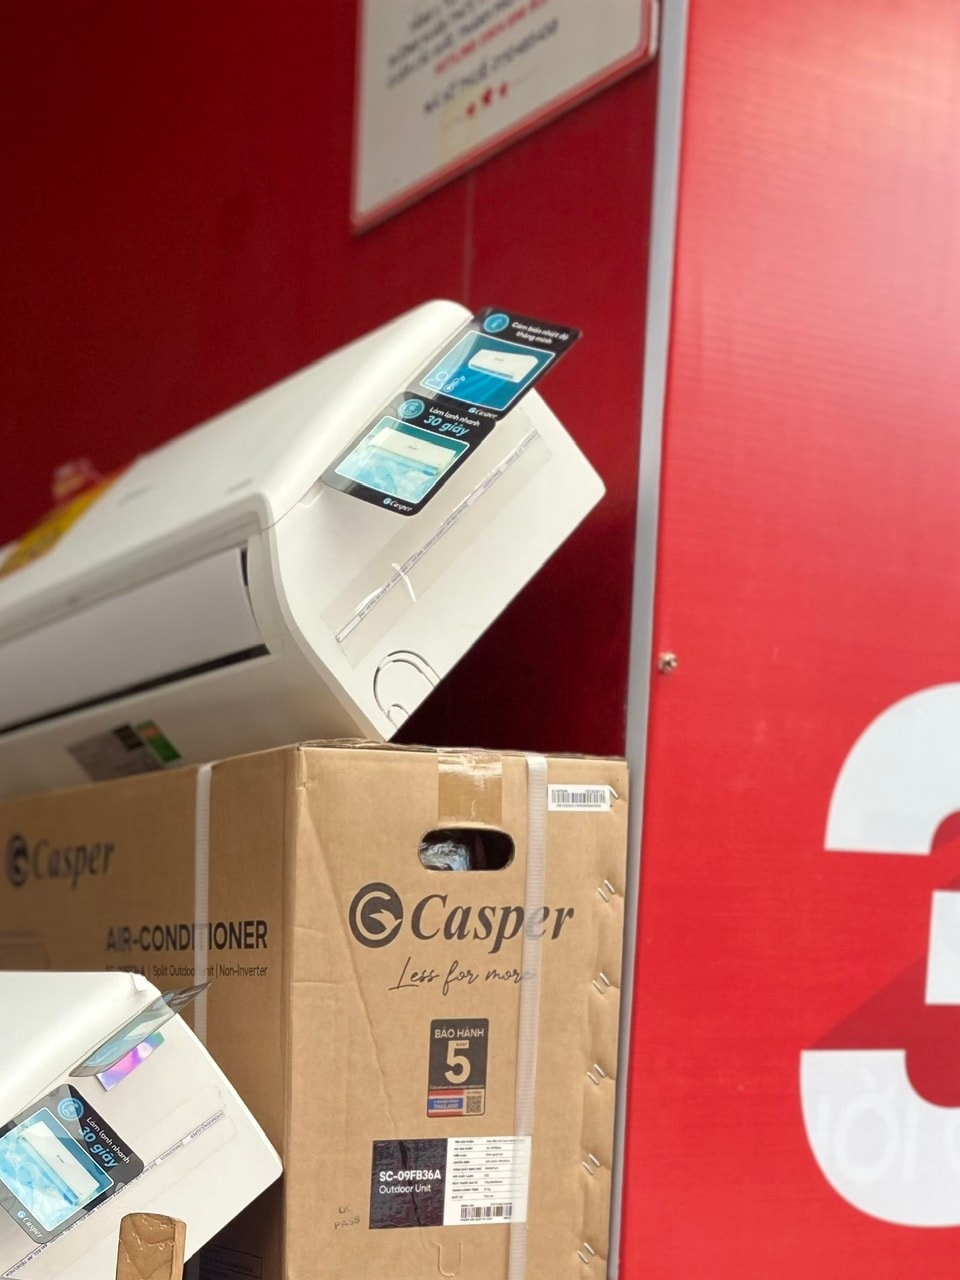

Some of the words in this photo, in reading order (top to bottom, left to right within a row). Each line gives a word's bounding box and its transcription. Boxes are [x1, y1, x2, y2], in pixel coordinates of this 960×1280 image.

[423, 414, 441, 427] 30
[441, 417, 471, 438] giây
[459, 415, 480, 427] nhanh
[31, 839, 116, 890] Casper
[410, 893, 575, 954] Casper
[153, 964, 168, 979] Split
[170, 964, 198, 976] Outdoo
[218, 963, 269, 976] Non-Inverter
[388, 956, 441, 992] Less
[441, 960, 480, 996] for
[434, 1025, 455, 1039] BẢO
[457, 1027, 485, 1038] HÀNH
[444, 1039, 471, 1084] 5
[79, 1126, 96, 1142] 30
[90, 1144, 119, 1167] giây
[111, 1143, 130, 1164] nhanh
[379, 1169, 442, 1182] SC-09FB36A
[378, 1183, 413, 1194] Outdoor
[414, 1183, 431, 1193] Unit
[23, 1216, 44, 1239] Casper
